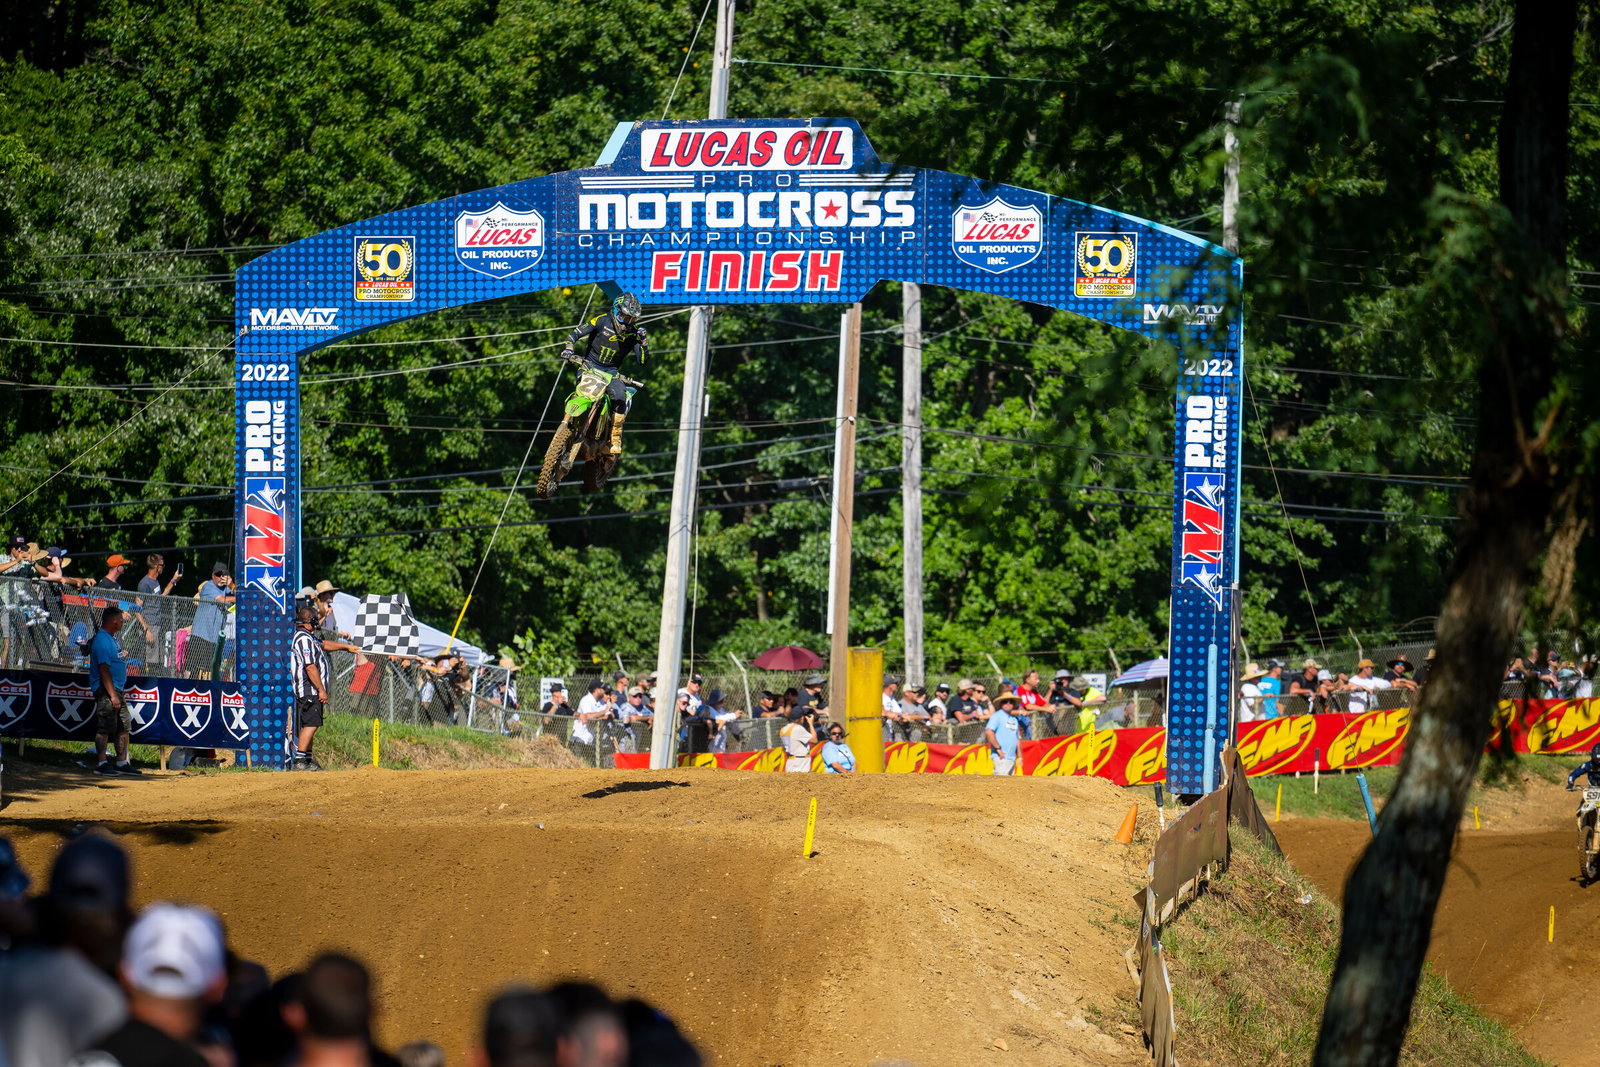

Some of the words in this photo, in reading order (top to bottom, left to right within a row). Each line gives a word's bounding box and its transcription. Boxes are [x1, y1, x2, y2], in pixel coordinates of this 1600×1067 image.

[649, 131, 778, 168] LUCAS
[784, 130, 844, 167] OIL
[702, 174, 792, 188] PRO
[578, 191, 916, 231] MOTOCROSS
[465, 228, 537, 246] LUCAS
[578, 231, 916, 247] CHAMPIONSHIP
[963, 223, 1035, 240] LUCAS
[363, 243, 408, 277] 50
[461, 250, 479, 259] OIL
[482, 249, 539, 259] PRODUCTS
[958, 245, 976, 254] OIL
[979, 245, 1036, 254] PRODUCTS
[986, 257, 1009, 265] INC.
[1084, 239, 1130, 273] 50
[490, 262, 512, 270] INC.
[650, 250, 844, 292] FINISH
[241, 364, 290, 381] 2022
[1184, 359, 1233, 376] 2022
[245, 400, 271, 472] PRO
[272, 400, 285, 472] RACING
[1184, 395, 1213, 467] PRO
[1212, 395, 1228, 468] RACING
[51, 689, 94, 697] RACER
[175, 695, 209, 703] RACER
[58, 699, 84, 722] X
[181, 705, 202, 728] X
[230, 707, 249, 730] X
[1238, 714, 1314, 771] FMF
[1330, 707, 1412, 770] FMF
